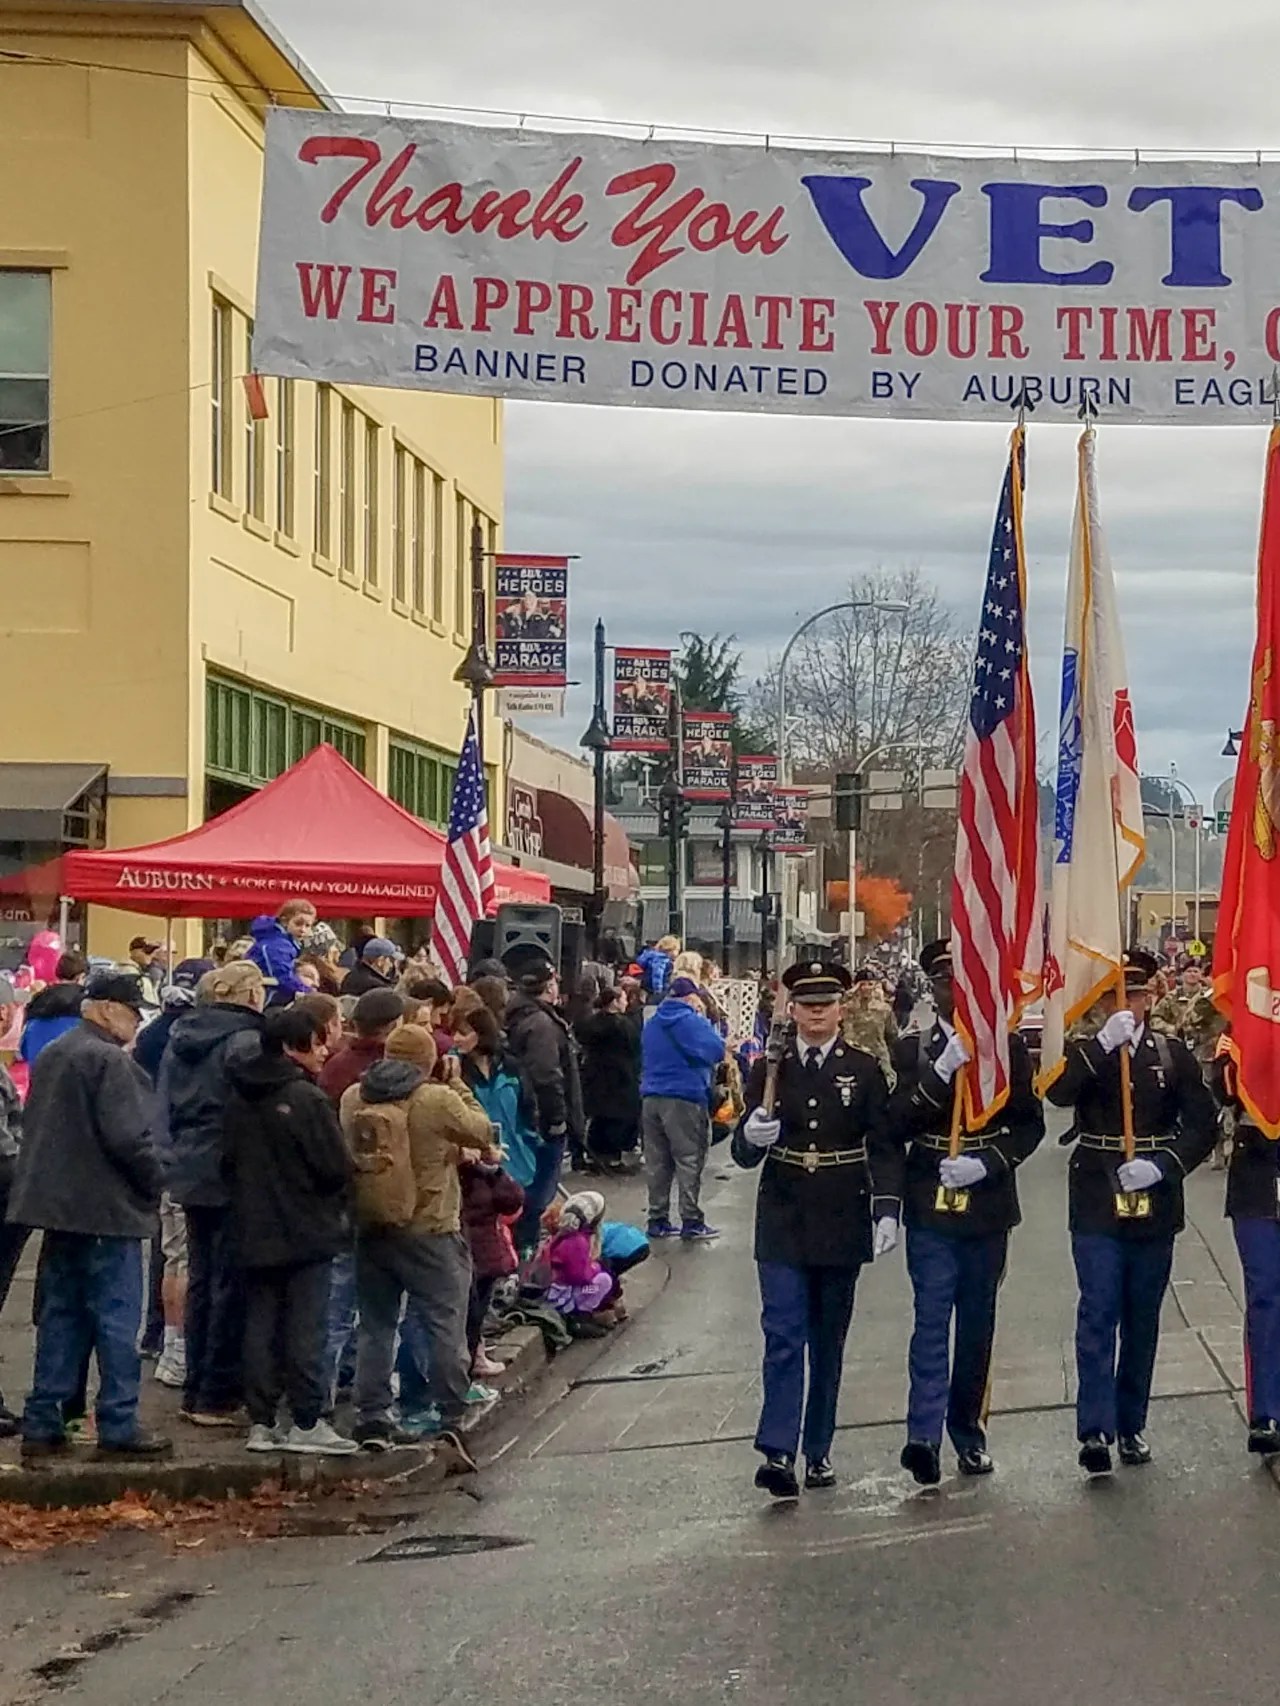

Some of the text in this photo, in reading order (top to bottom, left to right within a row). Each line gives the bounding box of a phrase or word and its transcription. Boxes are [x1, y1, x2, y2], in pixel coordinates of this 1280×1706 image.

[298, 136, 588, 244] Thank
[605, 163, 788, 287] You
[297, 263, 397, 324] WE
[425, 275, 834, 352] APPRECIATE
[864, 300, 1029, 360] YOUR
[1057, 307, 1237, 371] TIME,
[414, 344, 586, 384] BANNER
[631, 360, 827, 395] DONATED
[872, 371, 922, 399] BY
[962, 374, 1132, 406] AUBURN
[498, 579, 565, 593] HEROES
[499, 653, 563, 667] PARADE
[616, 667, 669, 679] HEROES
[616, 725, 665, 737] PARADE
[685, 728, 730, 738] HEROES
[687, 776, 728, 787] PARADE
[116, 866, 437, 898] AUBURN MORE THAN YOU IMAGINED
